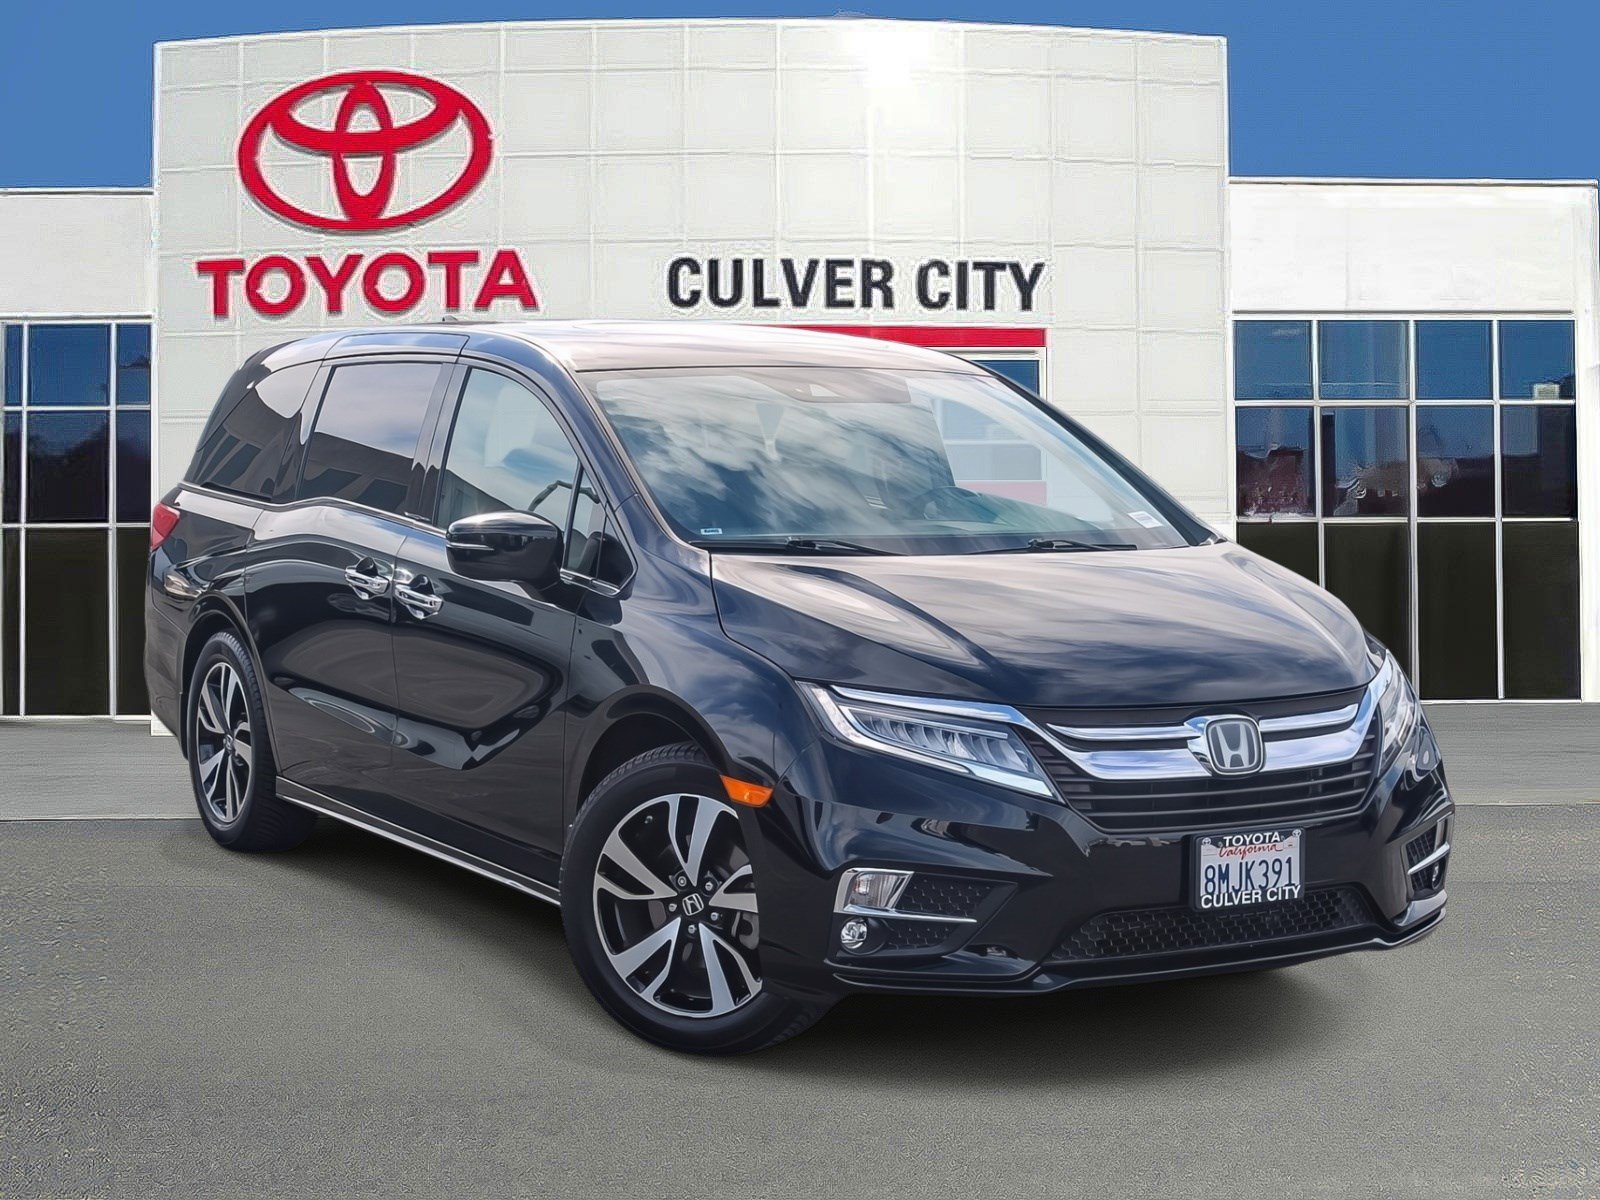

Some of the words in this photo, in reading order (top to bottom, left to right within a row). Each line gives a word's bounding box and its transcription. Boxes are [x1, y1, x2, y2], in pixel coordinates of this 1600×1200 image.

[196, 249, 538, 318] TOYOTA
[667, 256, 894, 309] CULVER
[915, 260, 1045, 311] CITY
[1219, 843, 1284, 860] California
[1223, 832, 1280, 847] TOYOTA
[1205, 857, 1296, 895] 8MJK391
[1201, 890, 1262, 908] CULVER
[1266, 885, 1301, 902] CITY
